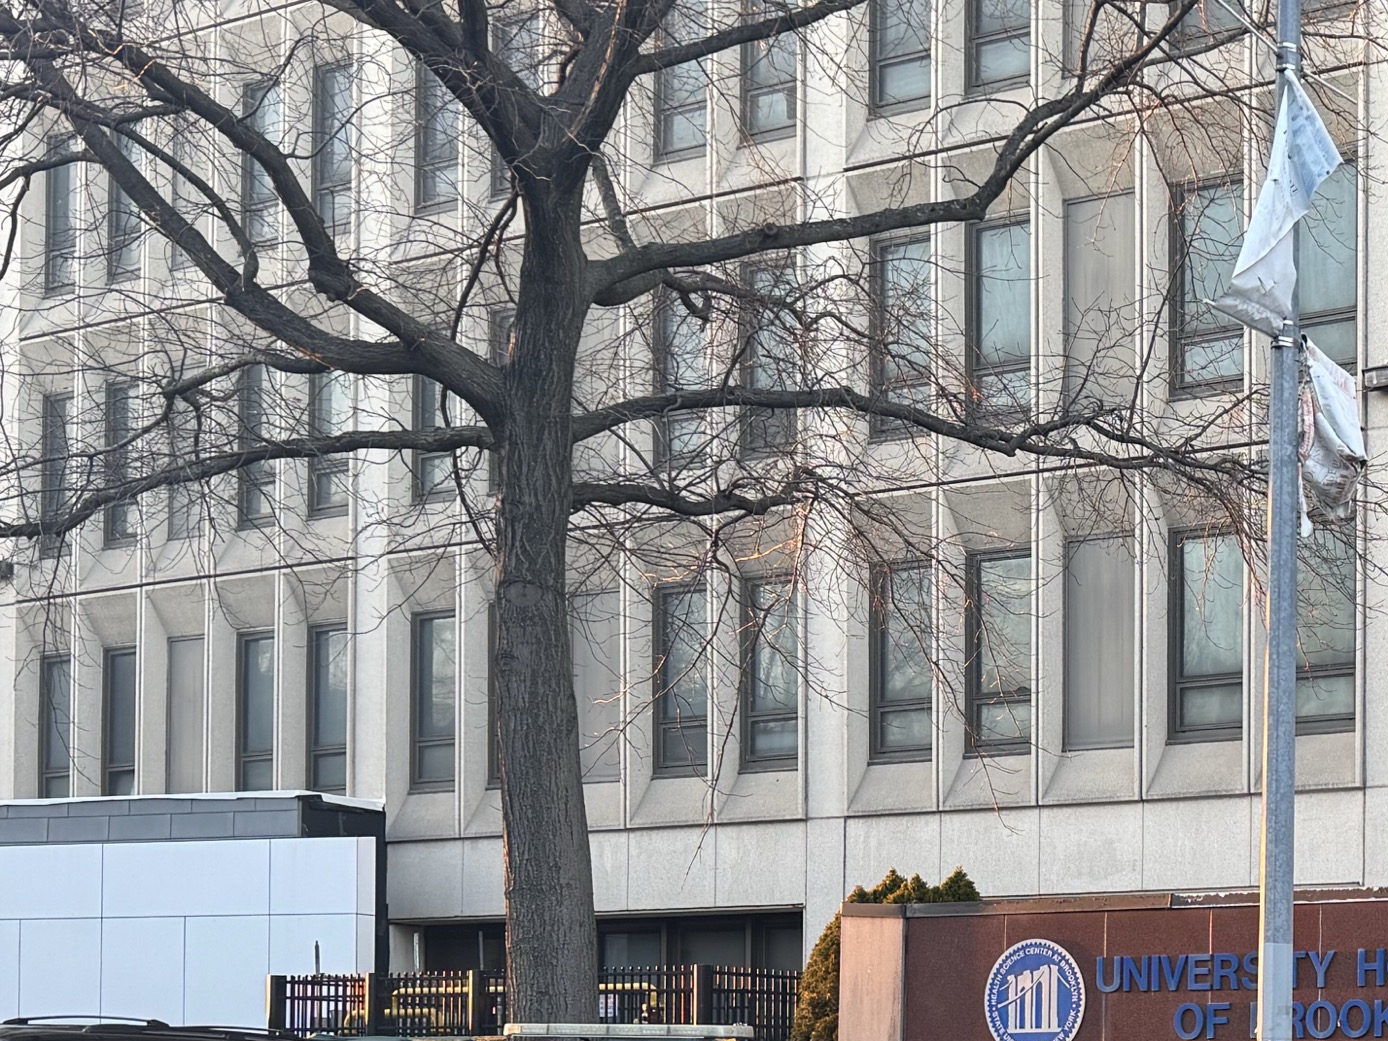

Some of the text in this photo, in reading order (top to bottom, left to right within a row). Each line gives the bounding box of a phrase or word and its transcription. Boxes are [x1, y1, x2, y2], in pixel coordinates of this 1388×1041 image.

[991, 947, 1078, 1005] HEALTH SCIENCE CENTER AT BROOKLYN
[992, 1011, 1006, 1035] STATE
[1064, 1009, 1077, 1032] YORK
[1174, 1002, 1231, 1041] OF
